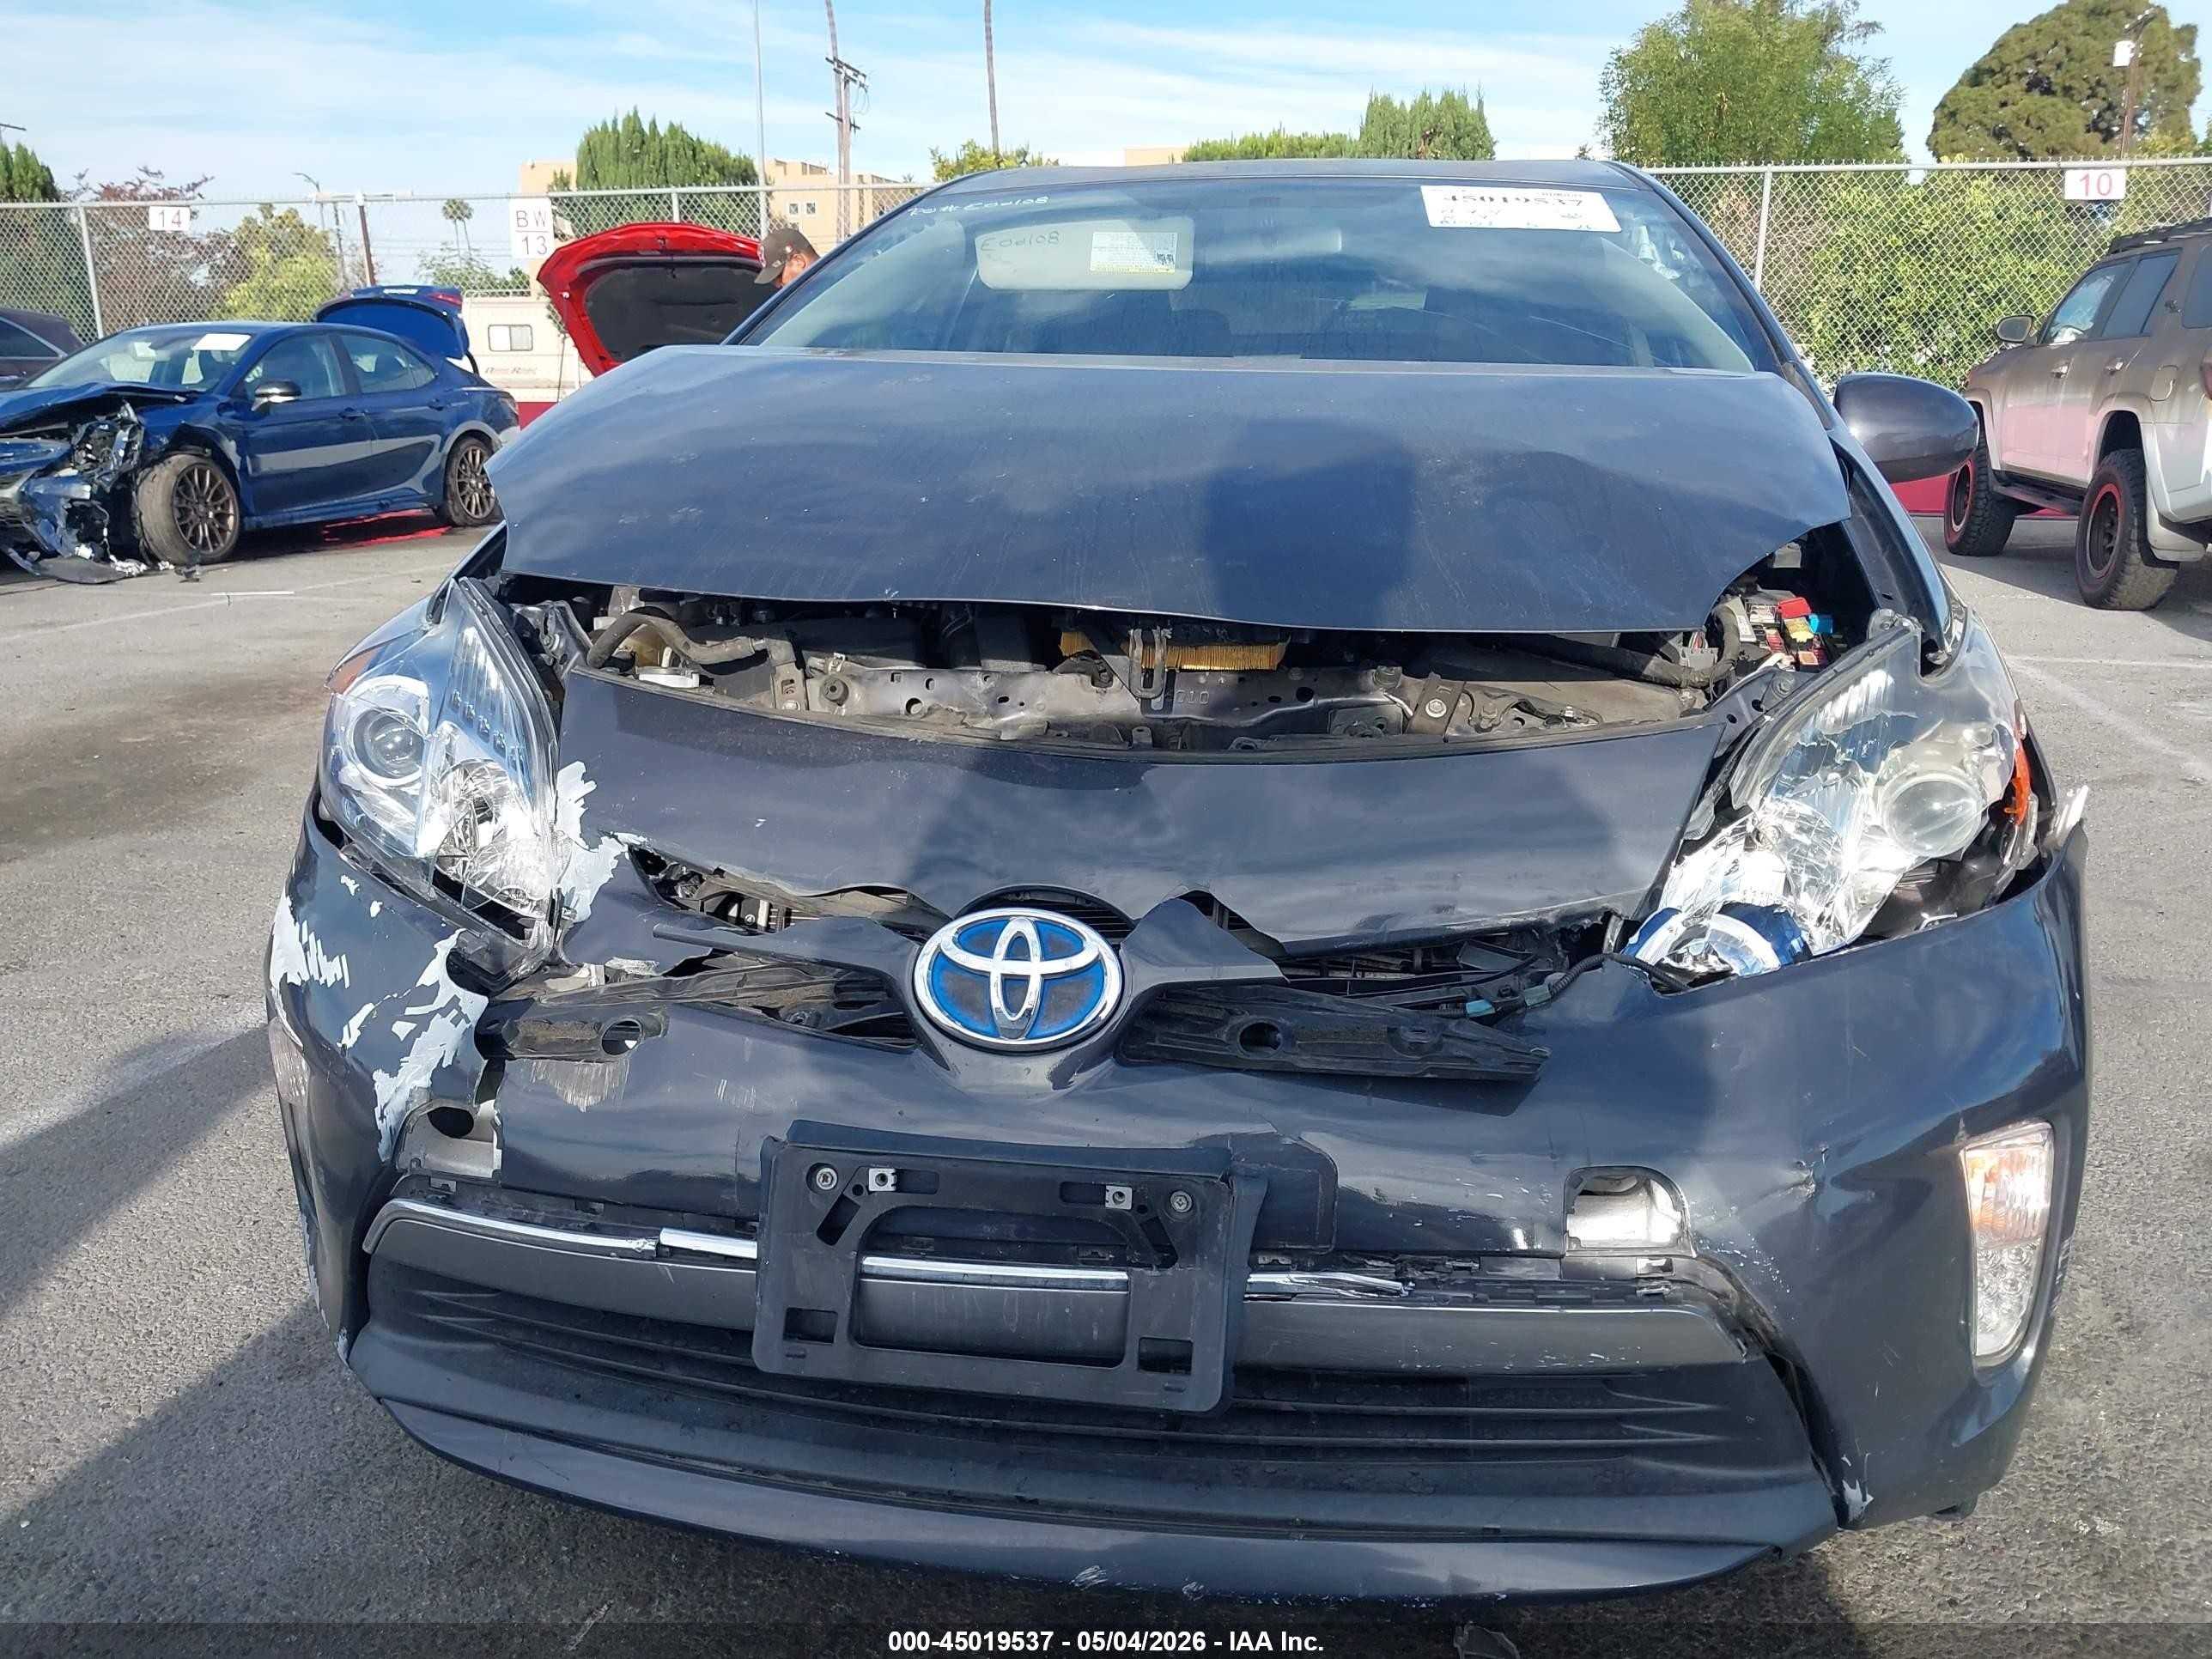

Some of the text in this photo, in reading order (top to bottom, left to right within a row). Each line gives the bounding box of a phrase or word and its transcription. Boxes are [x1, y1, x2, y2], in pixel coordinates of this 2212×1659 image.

[2079, 173, 2112, 197] 10
[158, 209, 182, 228] 14
[516, 210, 547, 228] BW
[521, 235, 548, 255] 13
